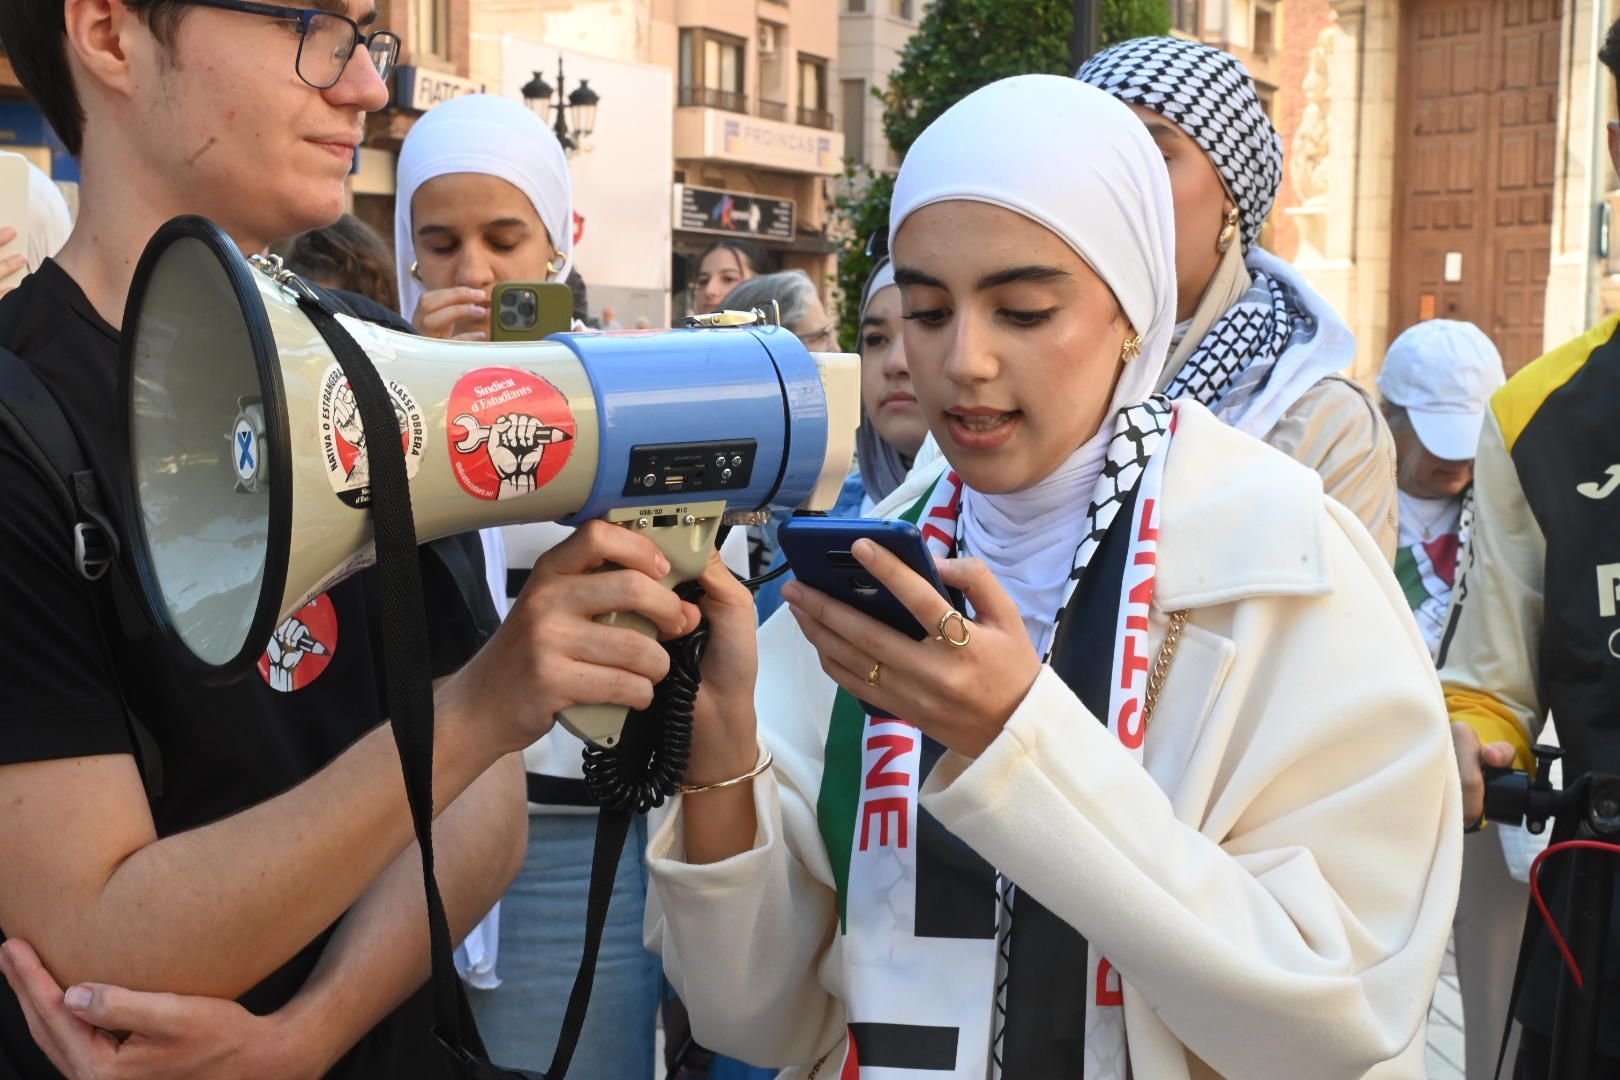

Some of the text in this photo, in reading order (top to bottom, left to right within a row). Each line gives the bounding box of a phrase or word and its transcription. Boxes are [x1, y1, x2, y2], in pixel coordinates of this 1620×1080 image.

[471, 385, 533, 413] d'Estudiants
[474, 378, 517, 398] Sindicat
[322, 423, 331, 431] O
[389, 381, 423, 457] CLASSE OBRERA
[324, 434, 338, 472] NATIVA
